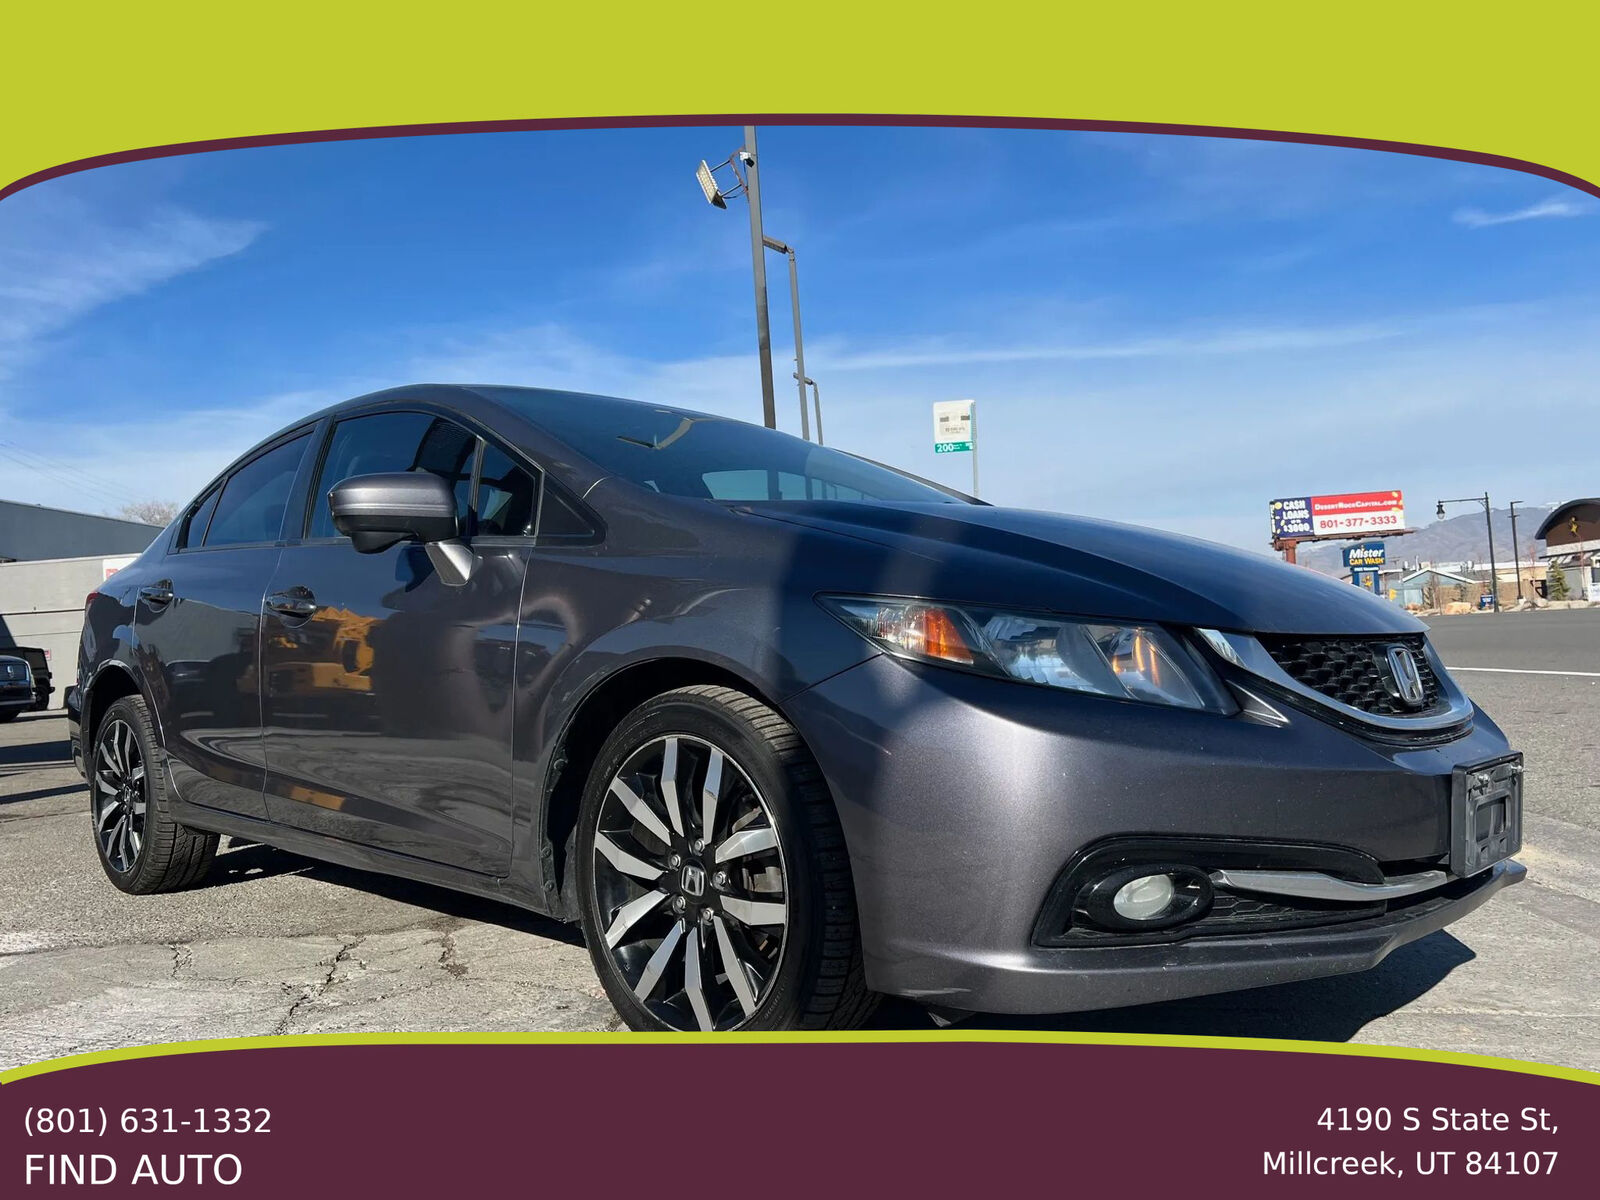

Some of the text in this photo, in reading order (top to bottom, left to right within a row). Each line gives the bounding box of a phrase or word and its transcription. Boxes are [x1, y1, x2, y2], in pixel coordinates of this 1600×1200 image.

[936, 443, 954, 453] 200
[1283, 500, 1306, 511] CASH
[1282, 509, 1310, 520] LOANS
[1319, 515, 1398, 529] 801-377-3333
[1349, 548, 1384, 559] Mister
[1349, 557, 1385, 566] CAR WASH
